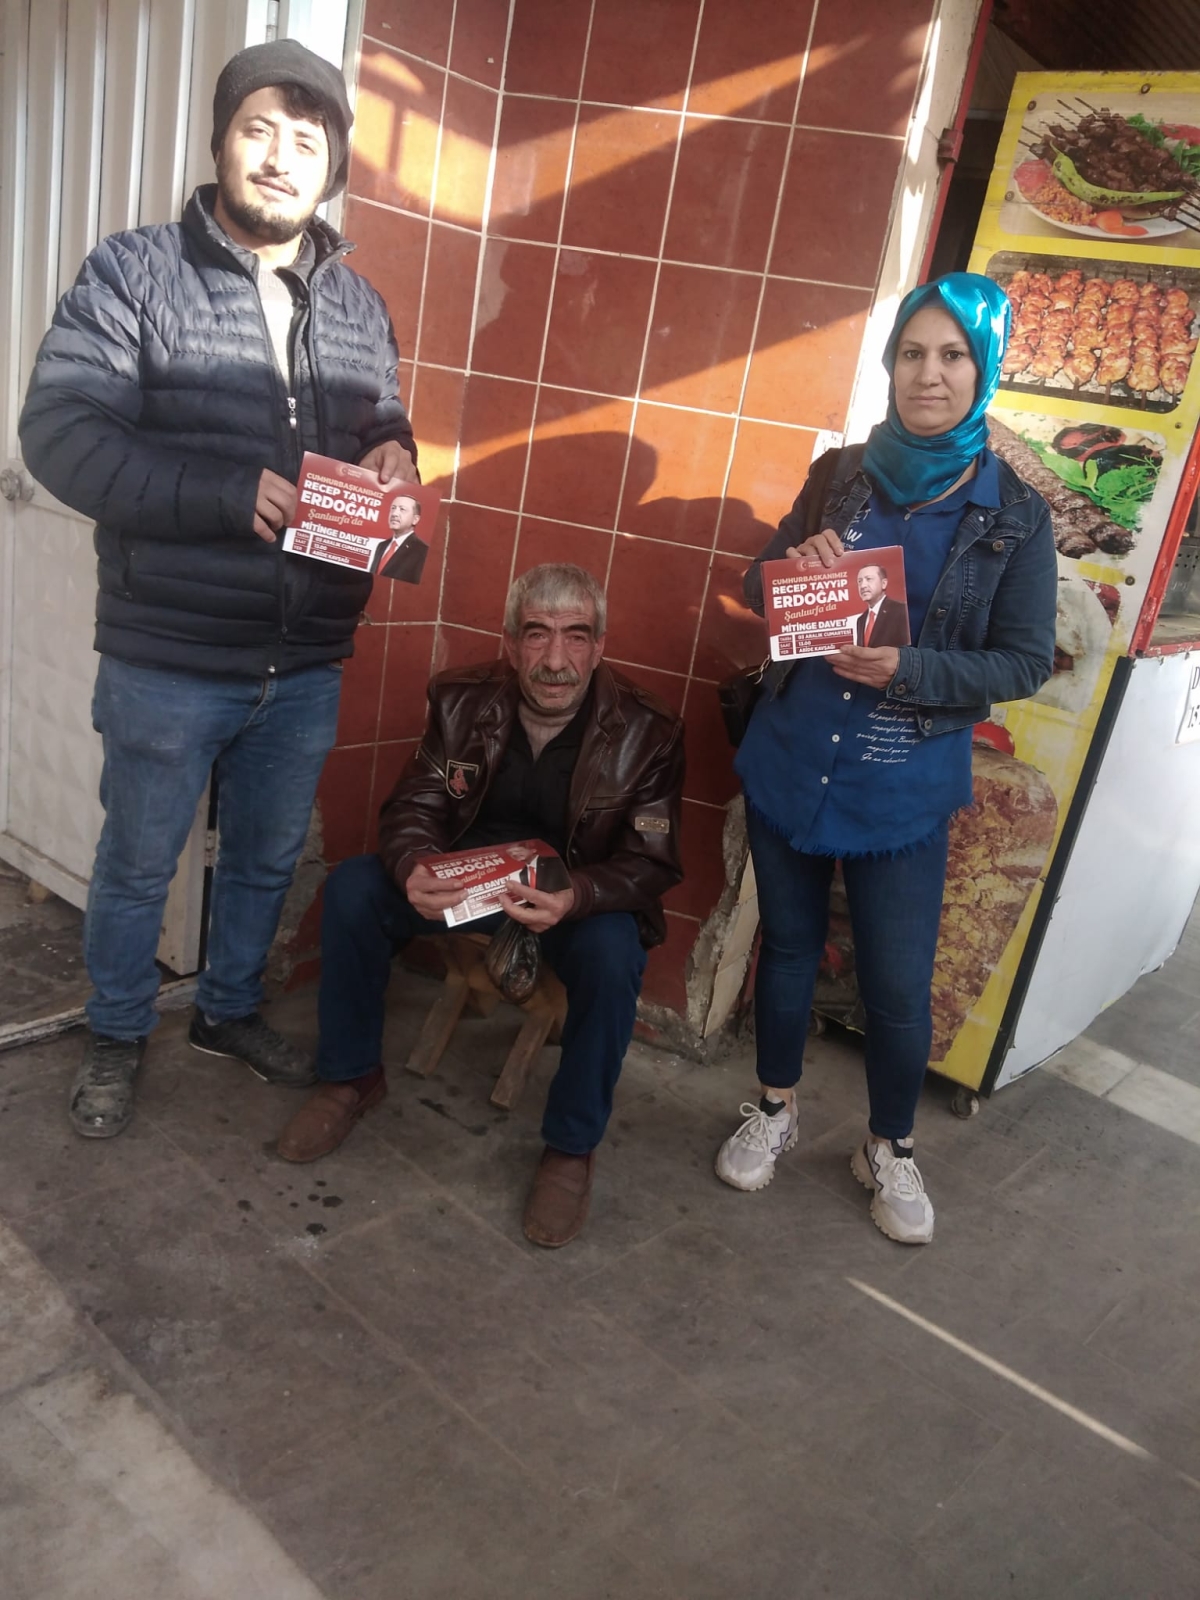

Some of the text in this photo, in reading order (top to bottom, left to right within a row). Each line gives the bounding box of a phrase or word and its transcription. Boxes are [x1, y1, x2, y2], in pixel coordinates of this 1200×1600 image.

[304, 479, 382, 507] RECEP TAYYİP
[306, 472, 384, 499] CUMHURBAŞKANIMIZ
[301, 489, 380, 522] ERDOĞAN
[301, 521, 369, 546] MİTİNGE DAVET
[772, 579, 848, 595] RECEP TAYYİP
[773, 589, 849, 609] ERDOĞAN
[781, 619, 847, 633] MİTİNGE DAVET
[431, 860, 463, 871] RECEP
